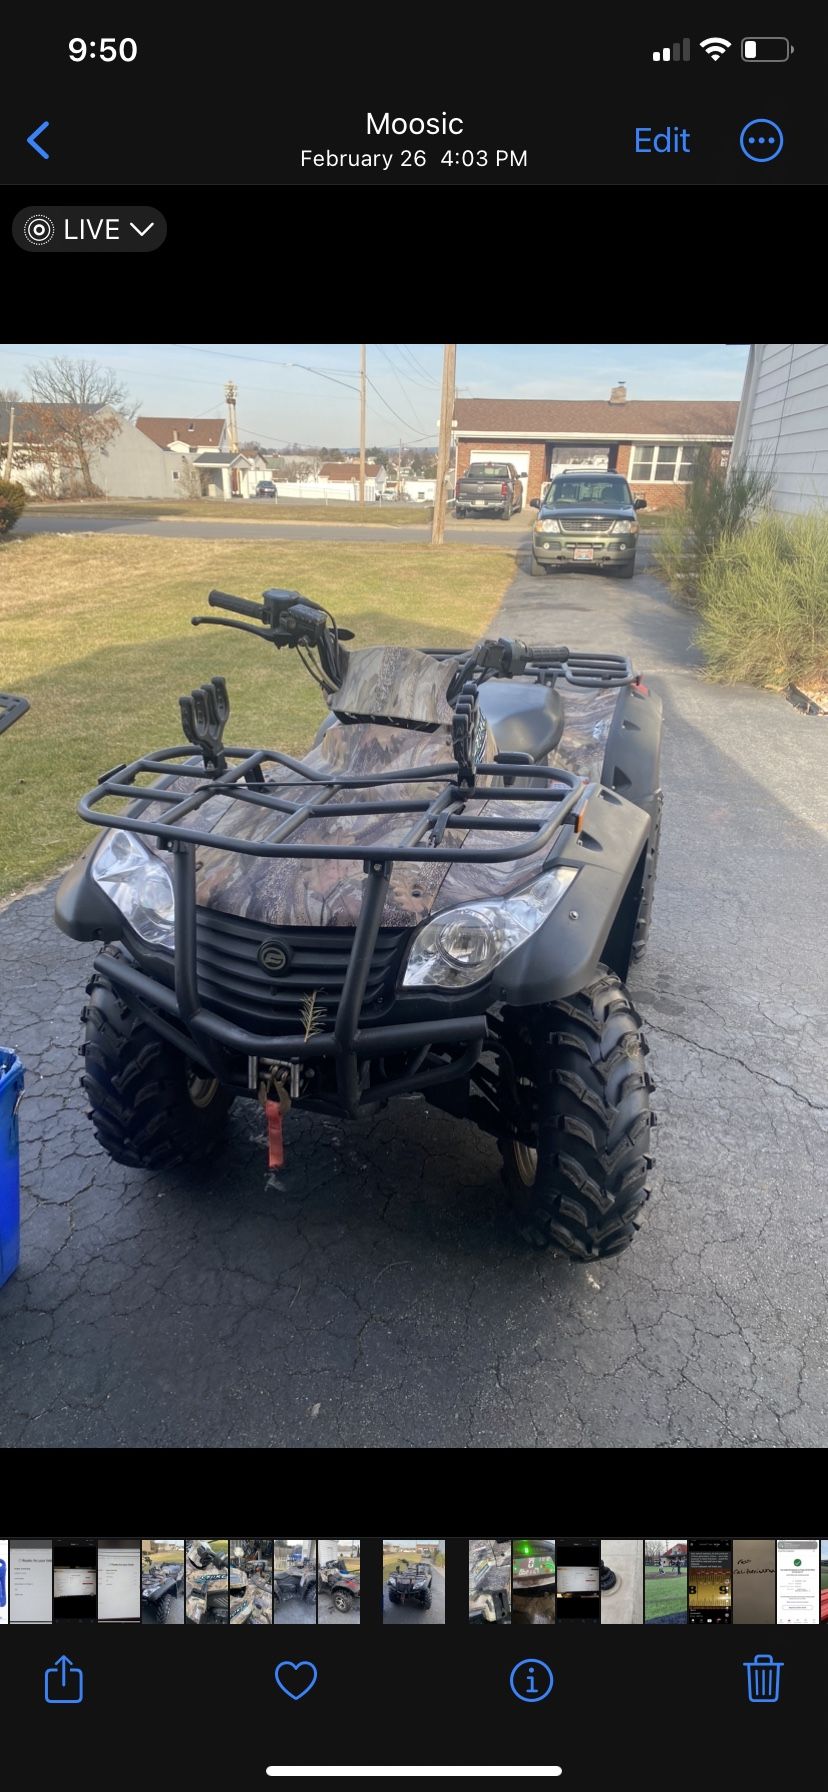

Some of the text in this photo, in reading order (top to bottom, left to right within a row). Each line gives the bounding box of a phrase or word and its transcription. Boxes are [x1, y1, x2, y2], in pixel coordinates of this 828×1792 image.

[68, 37, 138, 63] 9:50
[366, 111, 464, 135] Moosic
[635, 126, 691, 153] Edit
[301, 149, 528, 171] February 26 4:03 PM
[64, 218, 120, 240] LIVE
